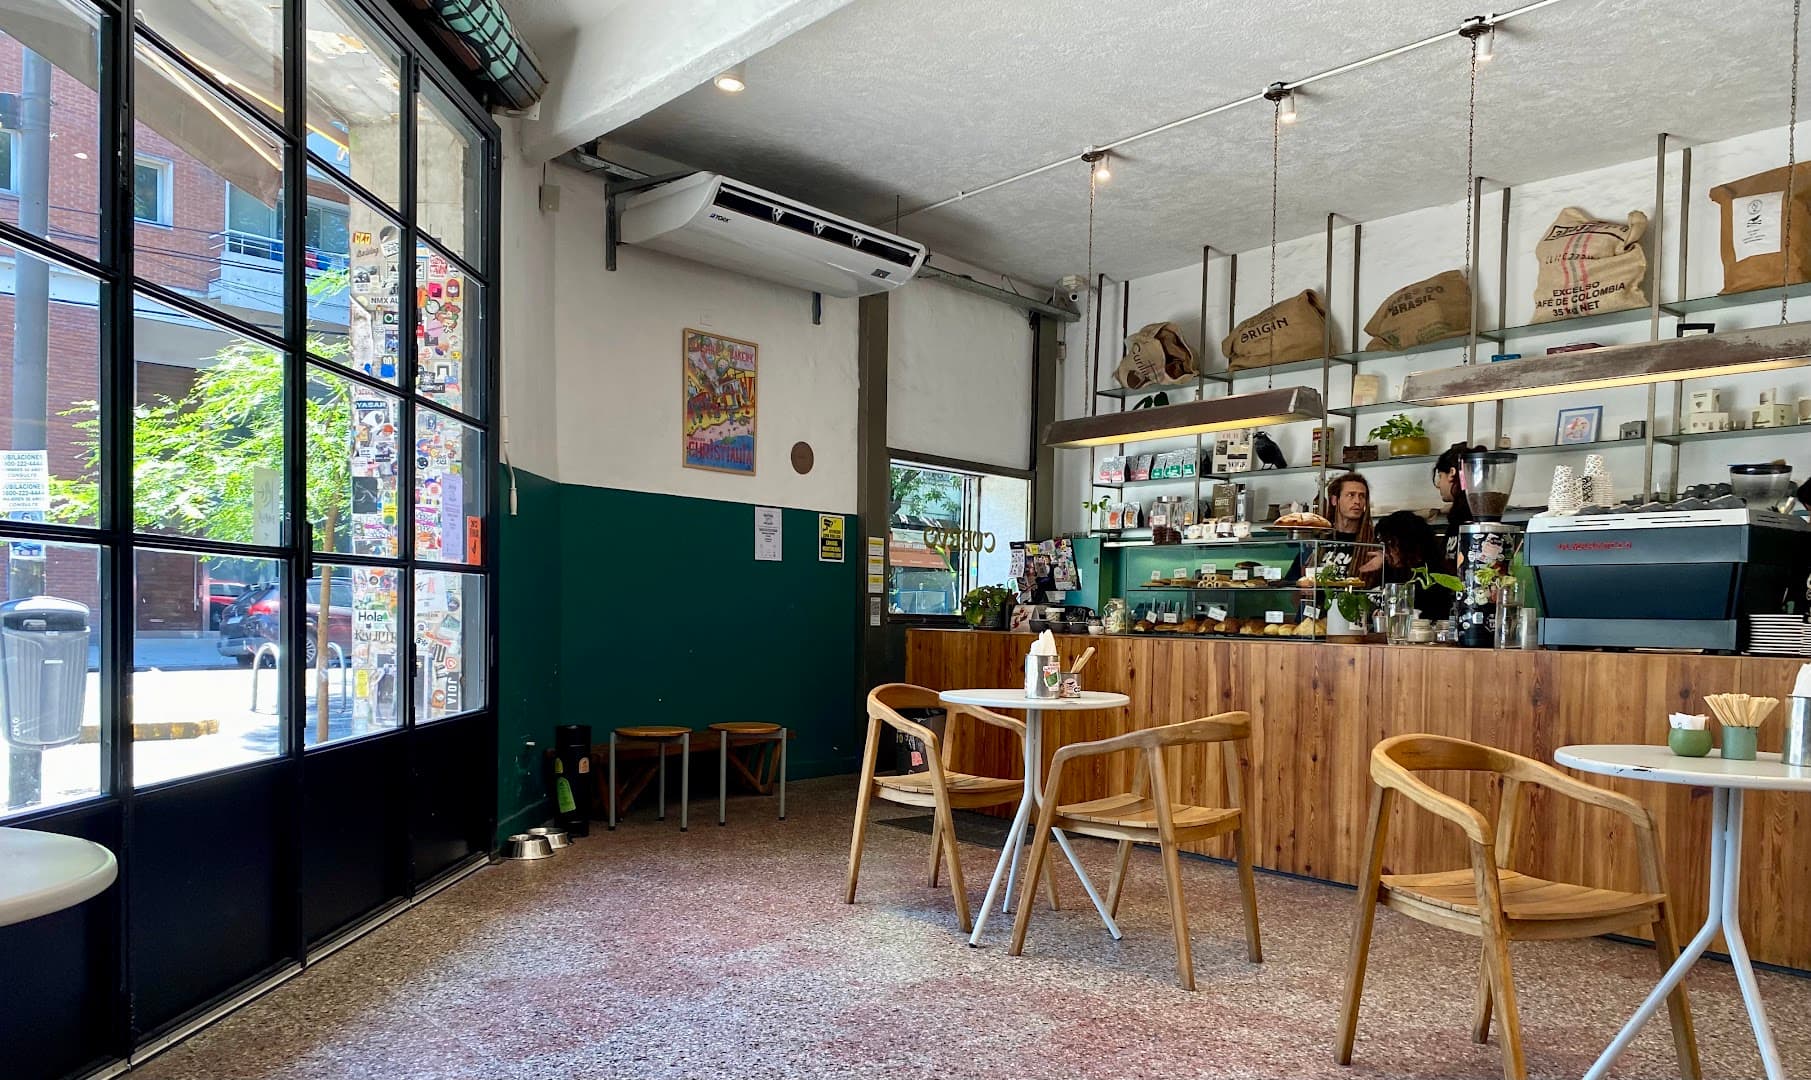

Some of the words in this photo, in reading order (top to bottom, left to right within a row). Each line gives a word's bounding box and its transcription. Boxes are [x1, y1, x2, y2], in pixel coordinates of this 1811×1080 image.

[1552, 281, 1600, 297] EXCELSO
[1555, 298, 1569, 306] DE
[1571, 282, 1625, 303] COLOMBIA
[1391, 294, 1436, 316] BRASIL
[1553, 308, 1564, 317] 35
[1579, 300, 1600, 312] NET
[358, 611, 383, 621] Hola
